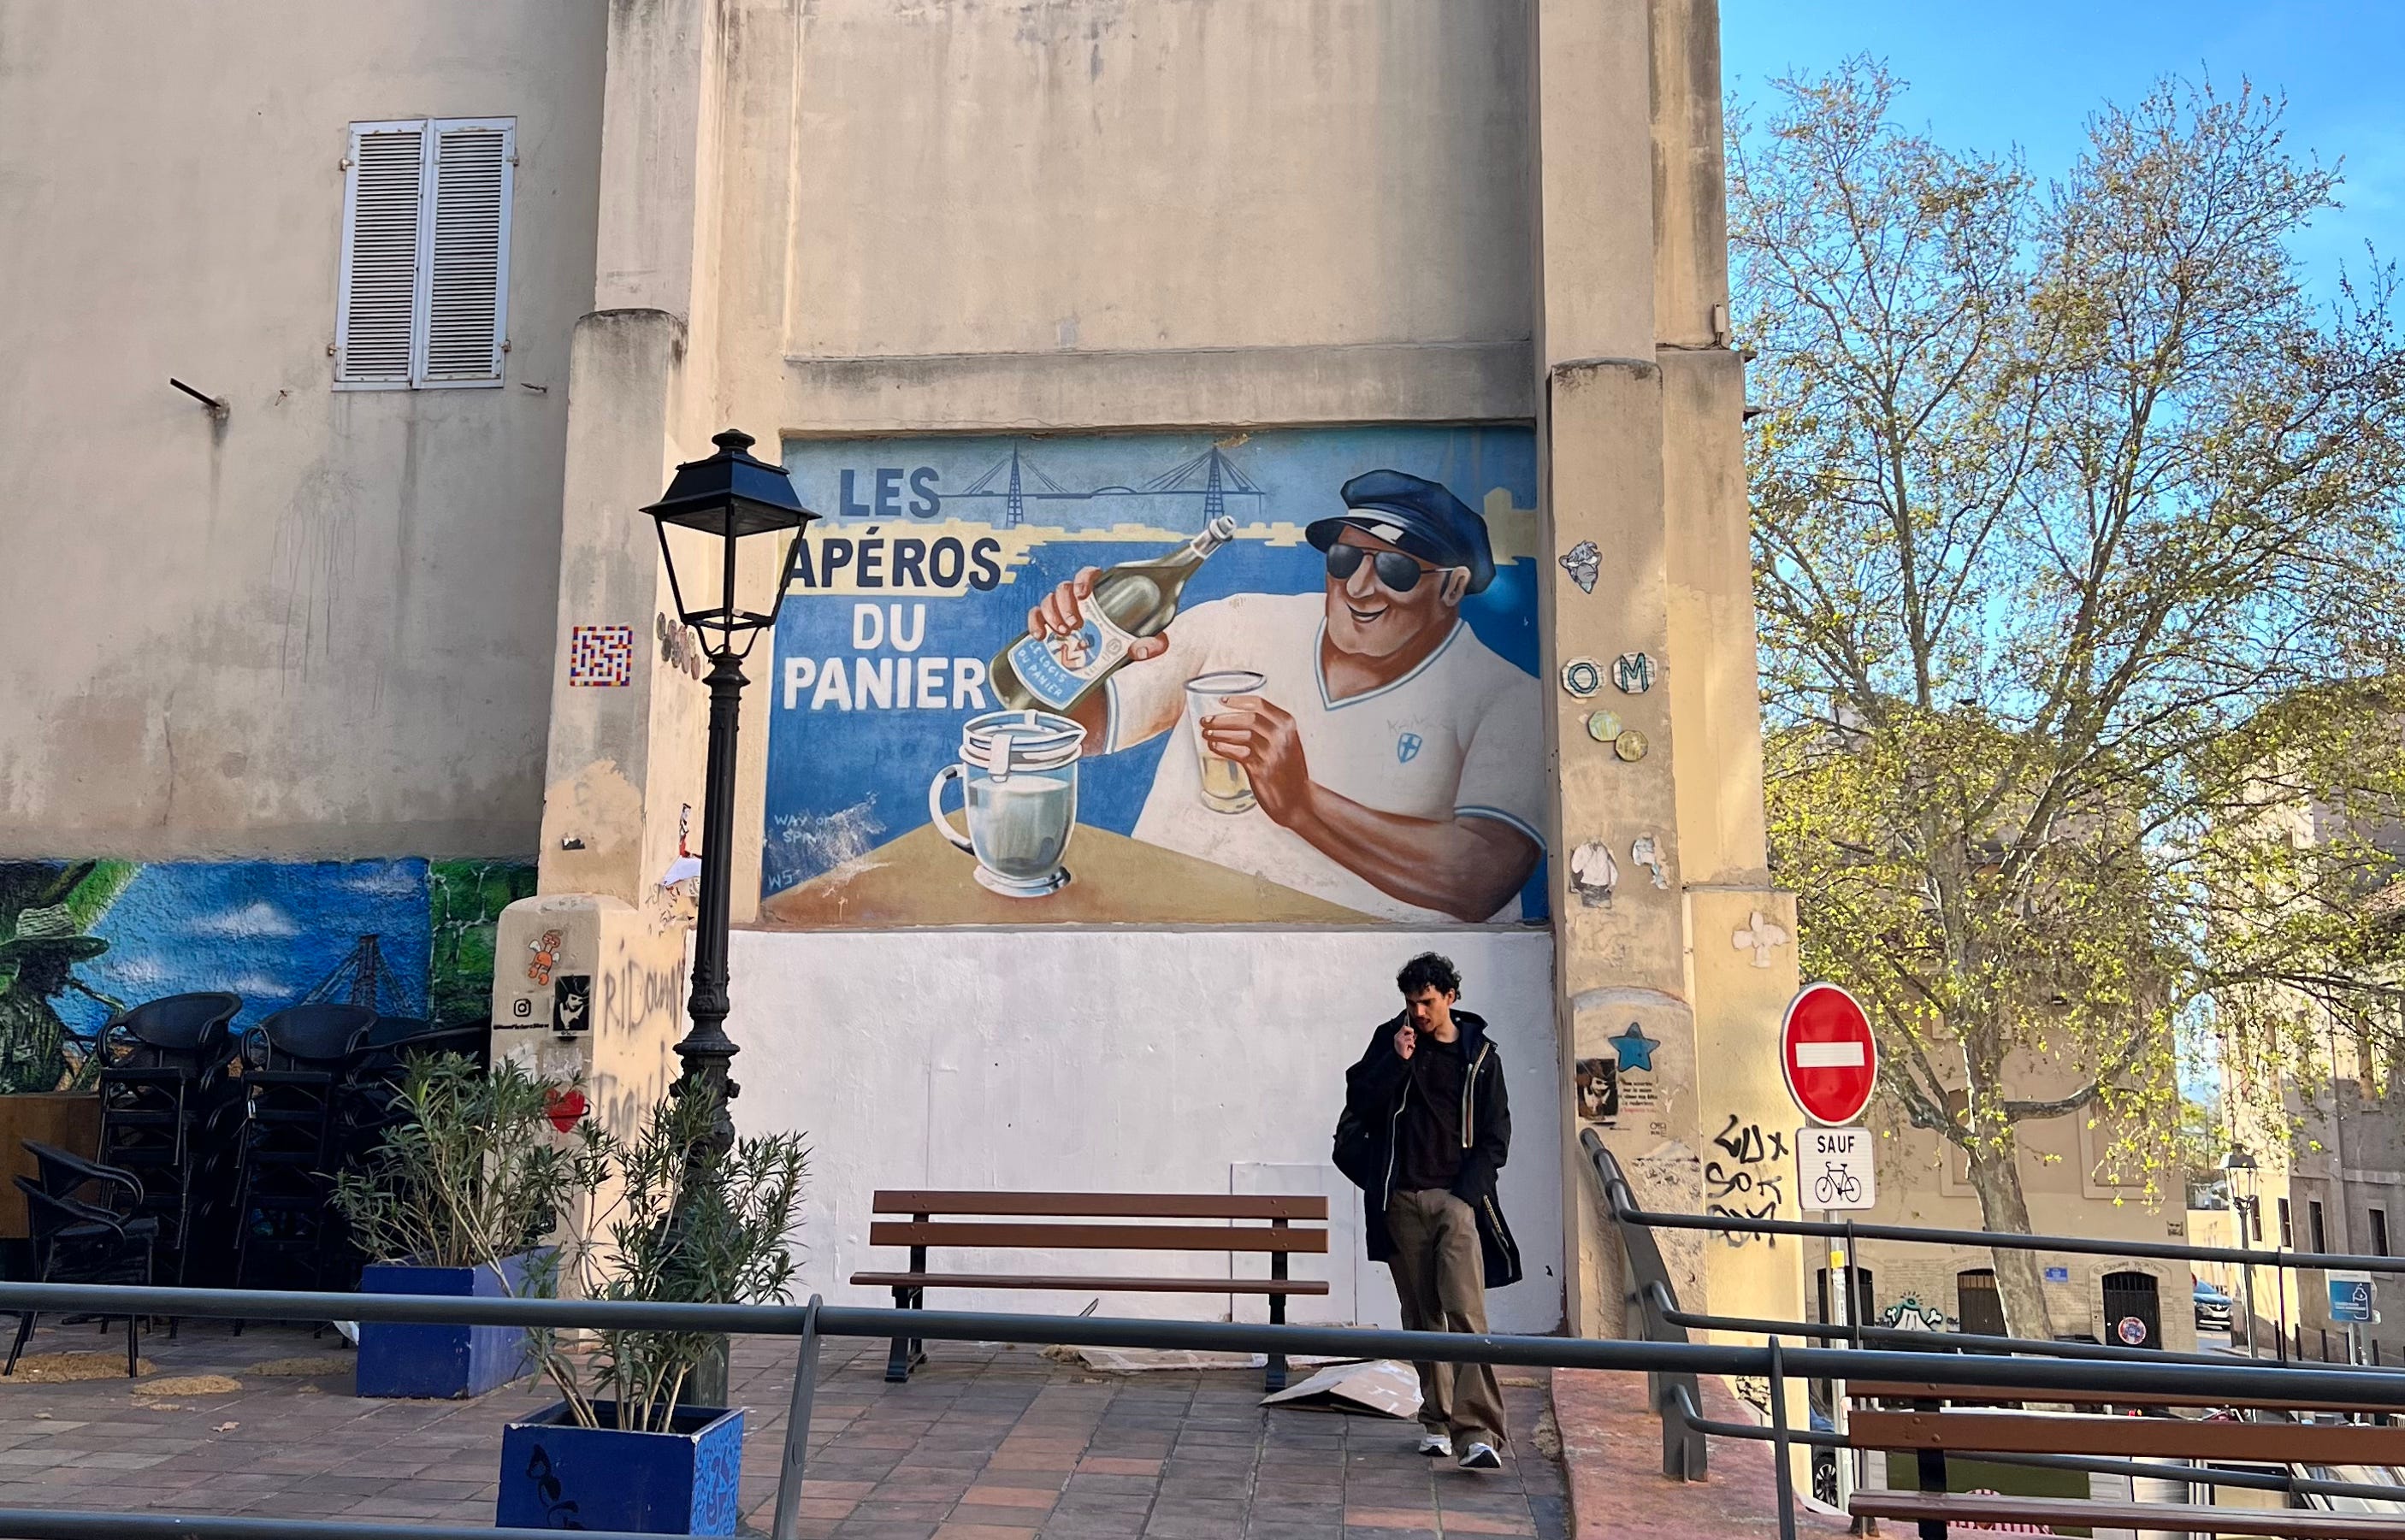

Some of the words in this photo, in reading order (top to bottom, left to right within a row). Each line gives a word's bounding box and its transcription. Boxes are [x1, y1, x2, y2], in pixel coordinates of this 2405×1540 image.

[839, 467, 941, 519] LES
[780, 526, 1002, 591] APÉROS
[852, 603, 926, 652] DU
[783, 657, 987, 711] PANIER
[1017, 649, 1030, 664] DU
[1028, 664, 1064, 697] PANIER
[1029, 641, 1042, 655] LE
[1039, 653, 1068, 683] LOGIS
[774, 814, 808, 828] WAY
[1817, 1136, 1855, 1154] SAUF
